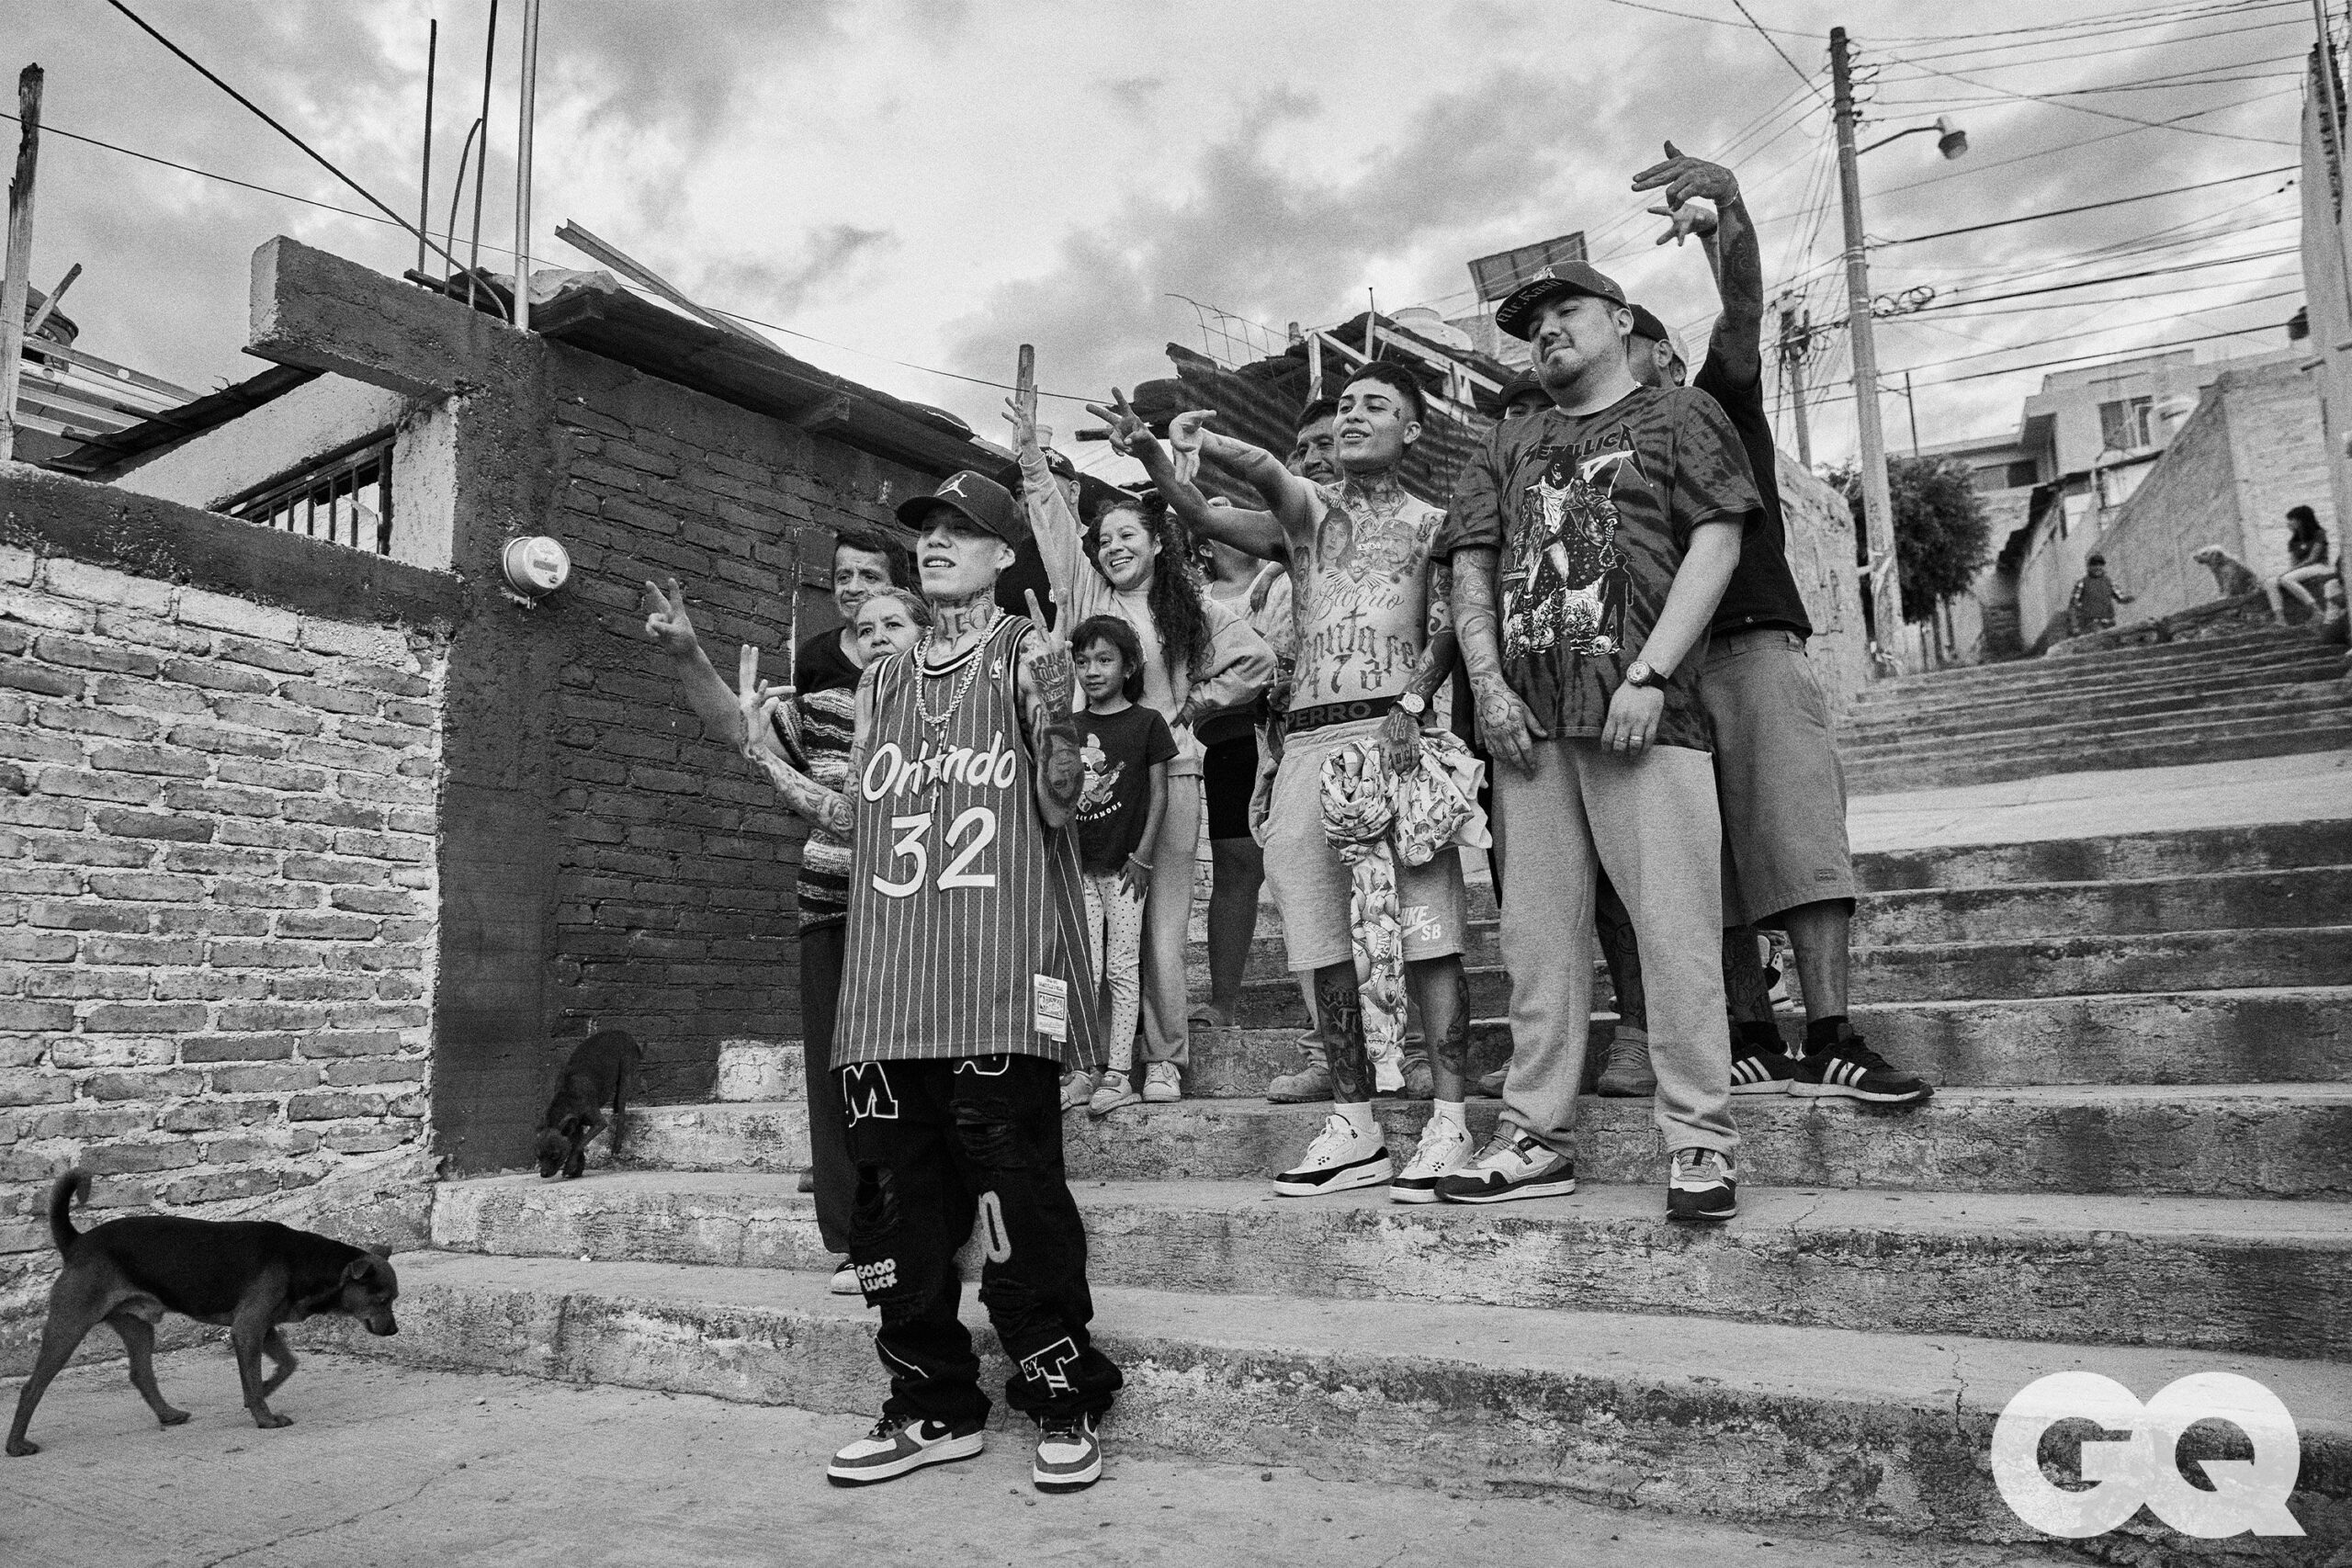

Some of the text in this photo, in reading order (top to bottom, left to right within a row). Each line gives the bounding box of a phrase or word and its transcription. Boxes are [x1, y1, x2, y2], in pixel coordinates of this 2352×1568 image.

[873, 807, 996, 897] 32
[1421, 924, 1441, 941] SB
[856, 1258, 897, 1279] GOOD
[863, 1272, 898, 1292] LUCK
